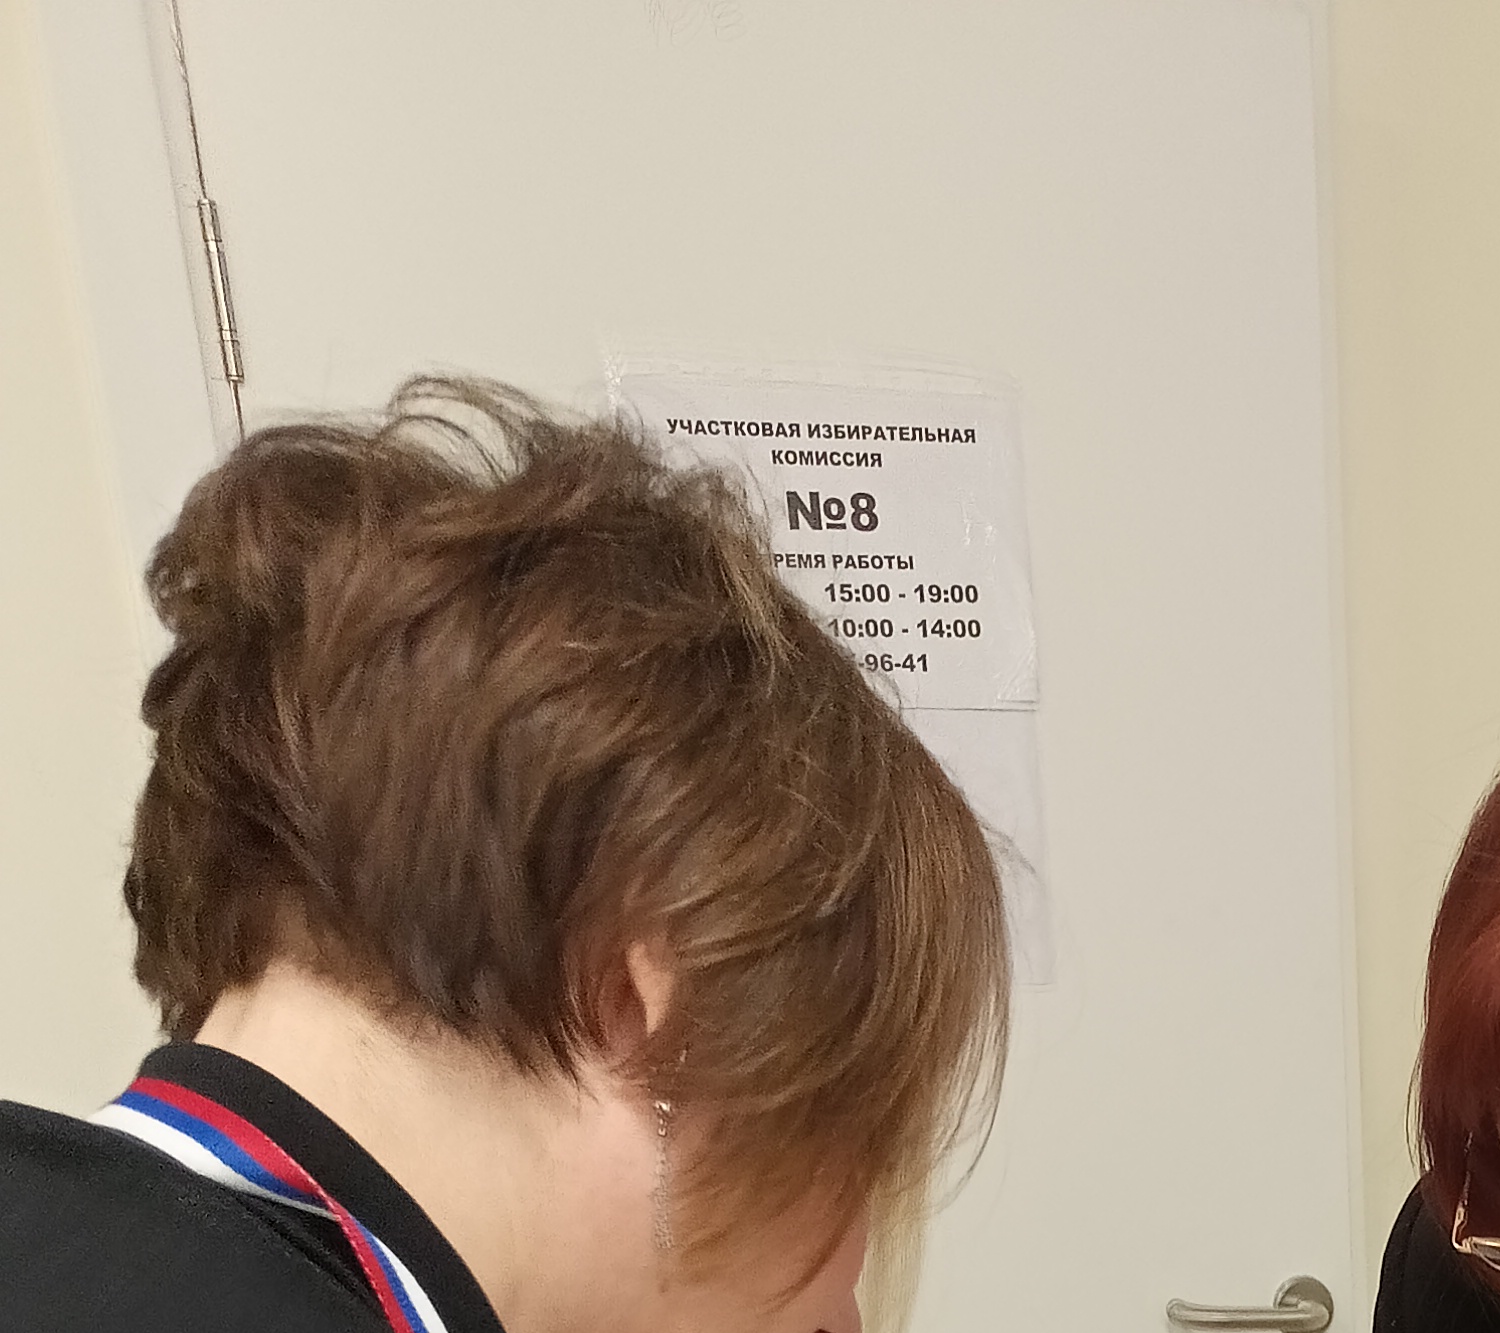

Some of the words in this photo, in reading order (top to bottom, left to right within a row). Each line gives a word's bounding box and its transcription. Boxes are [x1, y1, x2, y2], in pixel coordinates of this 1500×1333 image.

[667, 419, 800, 438] УЧАСТКОВАЯ
[807, 423, 976, 443] ИЗБИРАТЕЛЬНАЯ
[771, 450, 883, 467] КОМИССИЯ
[786, 490, 879, 532] №8
[773, 553, 826, 569] РЕМЯ
[832, 554, 915, 570] РАБОТЫ
[824, 583, 891, 602] 15:00
[913, 583, 979, 604] 19:00
[828, 618, 894, 638] 10:00
[916, 619, 982, 639] 14:00
[858, 653, 929, 673] -96-41
